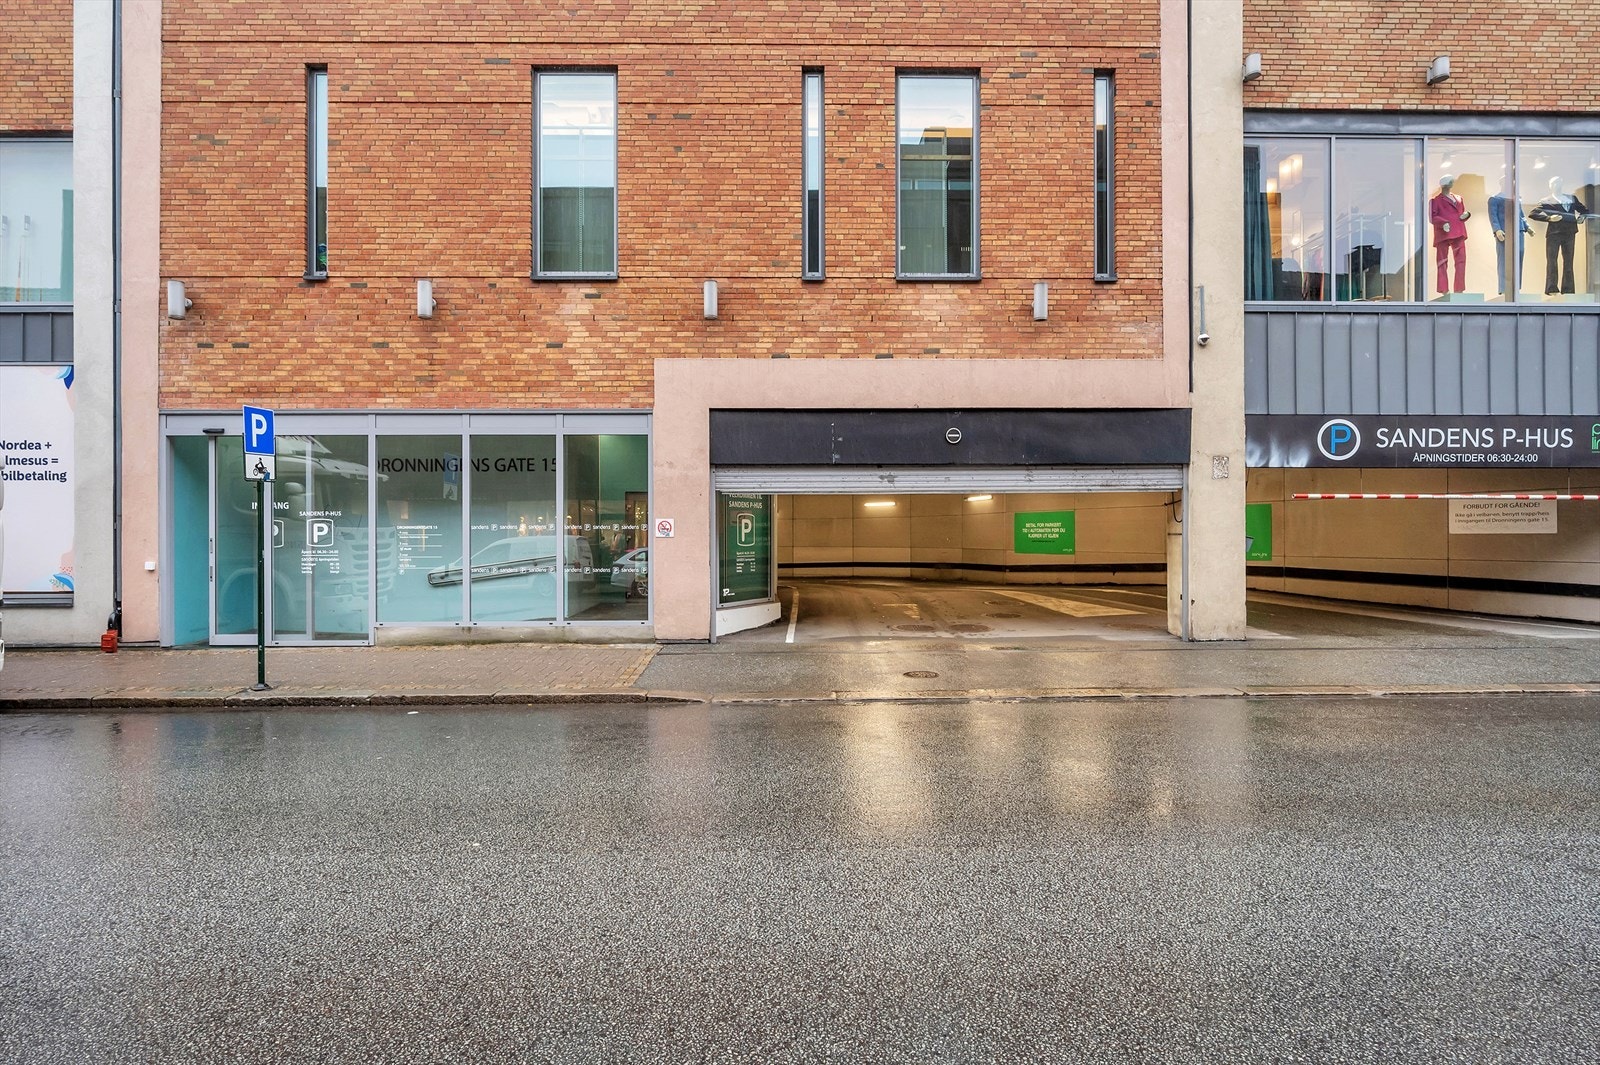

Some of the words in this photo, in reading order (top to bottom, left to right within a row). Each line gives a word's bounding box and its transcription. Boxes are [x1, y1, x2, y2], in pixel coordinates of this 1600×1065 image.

[251, 413, 267, 447] P
[1376, 427, 1495, 448] SANDENS
[1502, 427, 1574, 448] P-HUS
[0, 440, 42, 450] Nordea
[5, 455, 49, 466] lmesus
[494, 457, 536, 472] GATE
[541, 457, 556, 472] 15
[1412, 452, 1485, 463] ÅPNINGSTIDER
[1486, 453, 1539, 463] 06:30-24:00
[1, 470, 67, 483] bilbetaling
[728, 500, 750, 508] SANDENS
[313, 523, 329, 543] P
[741, 518, 752, 542] P
